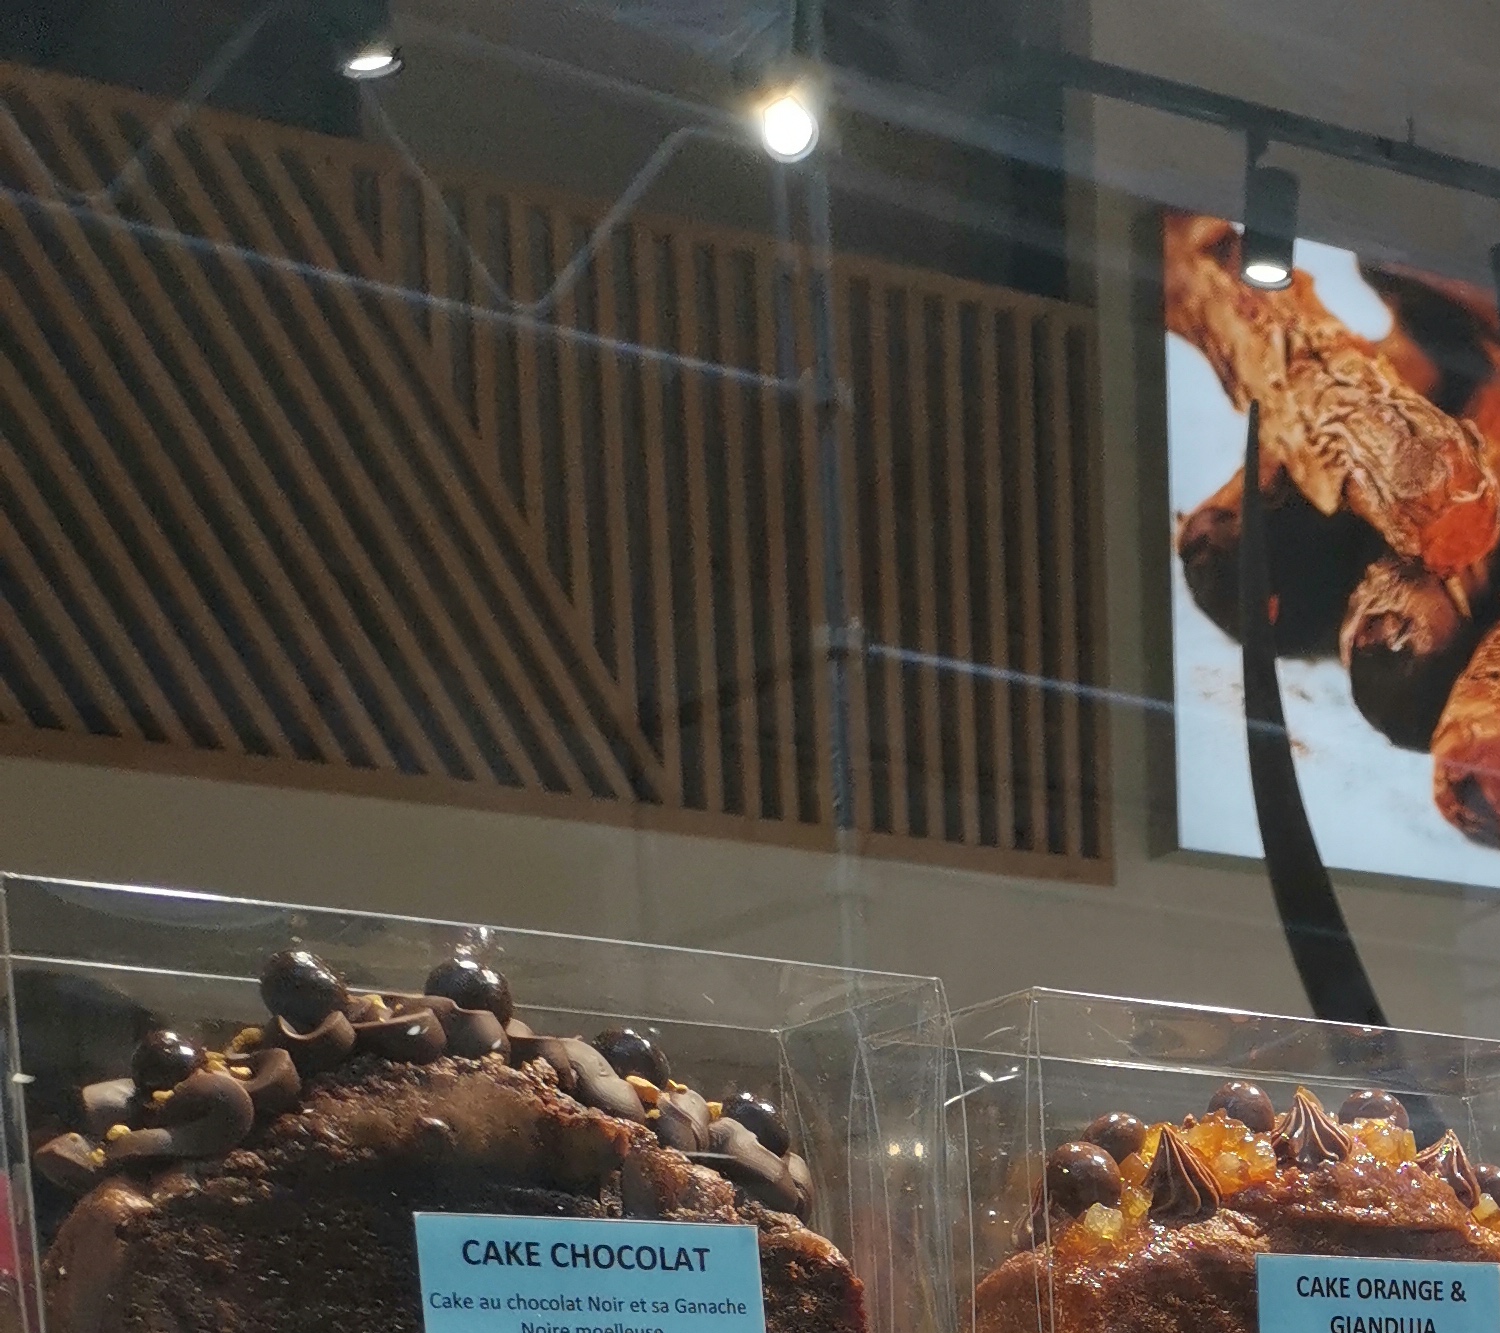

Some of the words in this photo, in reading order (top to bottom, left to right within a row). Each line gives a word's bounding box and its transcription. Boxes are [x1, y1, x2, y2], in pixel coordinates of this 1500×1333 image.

[461, 1238, 541, 1267] CAKE
[549, 1241, 709, 1272] CHOCOLAT
[429, 1290, 474, 1310] Cake
[478, 1296, 502, 1310] au
[505, 1293, 583, 1312] chocolat
[587, 1296, 624, 1313] Noir
[629, 1298, 648, 1313] et
[650, 1300, 670, 1314] sa
[673, 1298, 747, 1315] Ganache
[1295, 1274, 1350, 1299] CAKE
[1355, 1277, 1444, 1302] ORANGE
[1449, 1279, 1467, 1303] &
